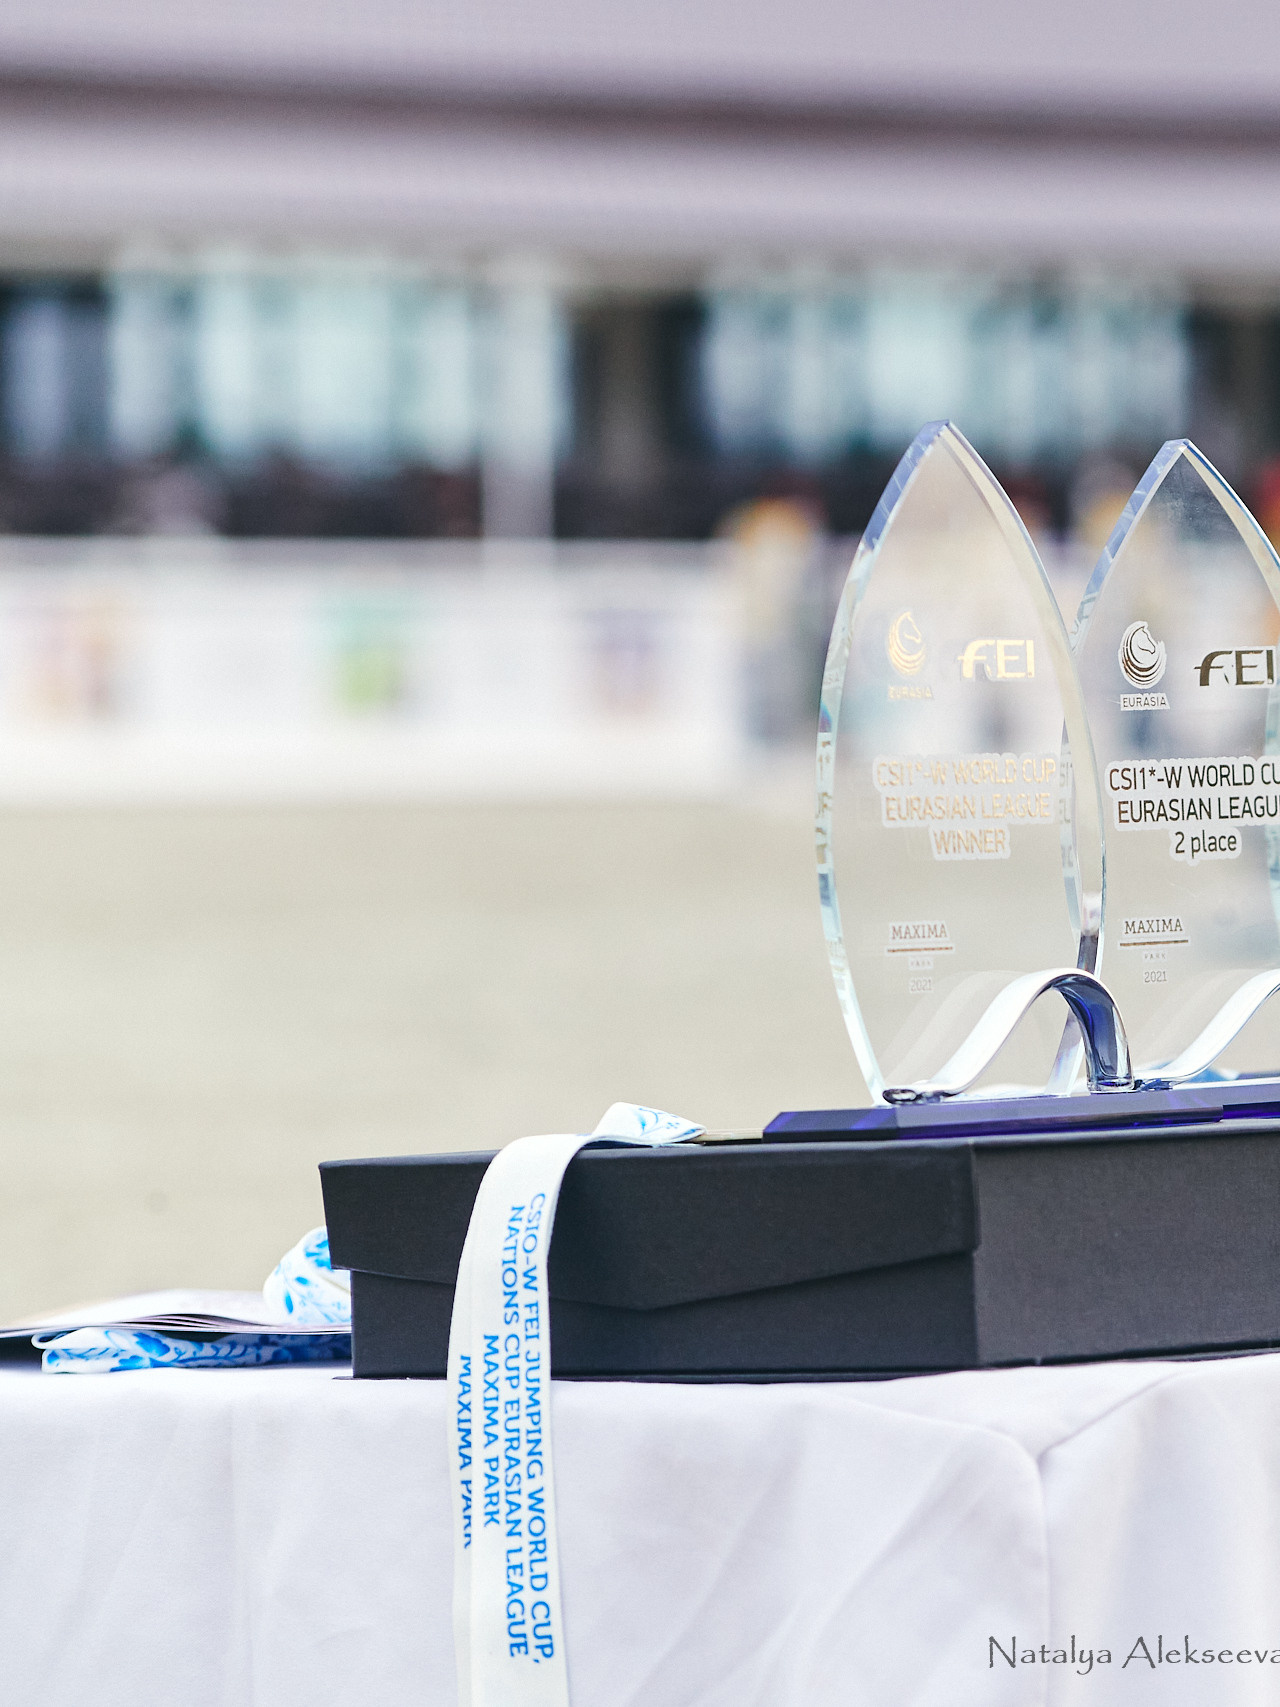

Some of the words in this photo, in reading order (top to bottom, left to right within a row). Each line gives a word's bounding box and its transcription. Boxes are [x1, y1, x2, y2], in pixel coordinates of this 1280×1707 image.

[957, 639, 1035, 679] FEI
[1193, 649, 1274, 687] FEI
[1122, 696, 1167, 708] EURASIA
[952, 759, 1017, 785] WORLD
[1022, 757, 1057, 784] CUP
[1188, 763, 1255, 788] WORLD
[885, 795, 976, 821] EURASIAN
[981, 792, 1051, 819] LEAGUE
[1118, 797, 1212, 824] EURASIAN
[933, 828, 1007, 855] WINNER
[1175, 831, 1185, 854] 2
[1190, 829, 1237, 860] place
[891, 923, 948, 940] MAXIMA
[1124, 918, 1183, 935] MAXIMA
[910, 978, 932, 992] 2021
[1144, 970, 1168, 983] 2021
[522, 1193, 546, 1292] CSIO-W
[502, 1205, 525, 1326] NATIONS
[524, 1300, 540, 1341] FEI
[504, 1333, 521, 1390] CUP
[483, 1334, 500, 1448] MAXIMA
[457, 1355, 472, 1471] MAXIMA
[525, 1350, 544, 1479] JUMPING
[504, 1400, 522, 1538] EURASIAN
[483, 1455, 501, 1528] PARK
[527, 1486, 548, 1592] WORLD
[506, 1546, 529, 1658] LEAGUE
[530, 1601, 554, 1664] CUP,
